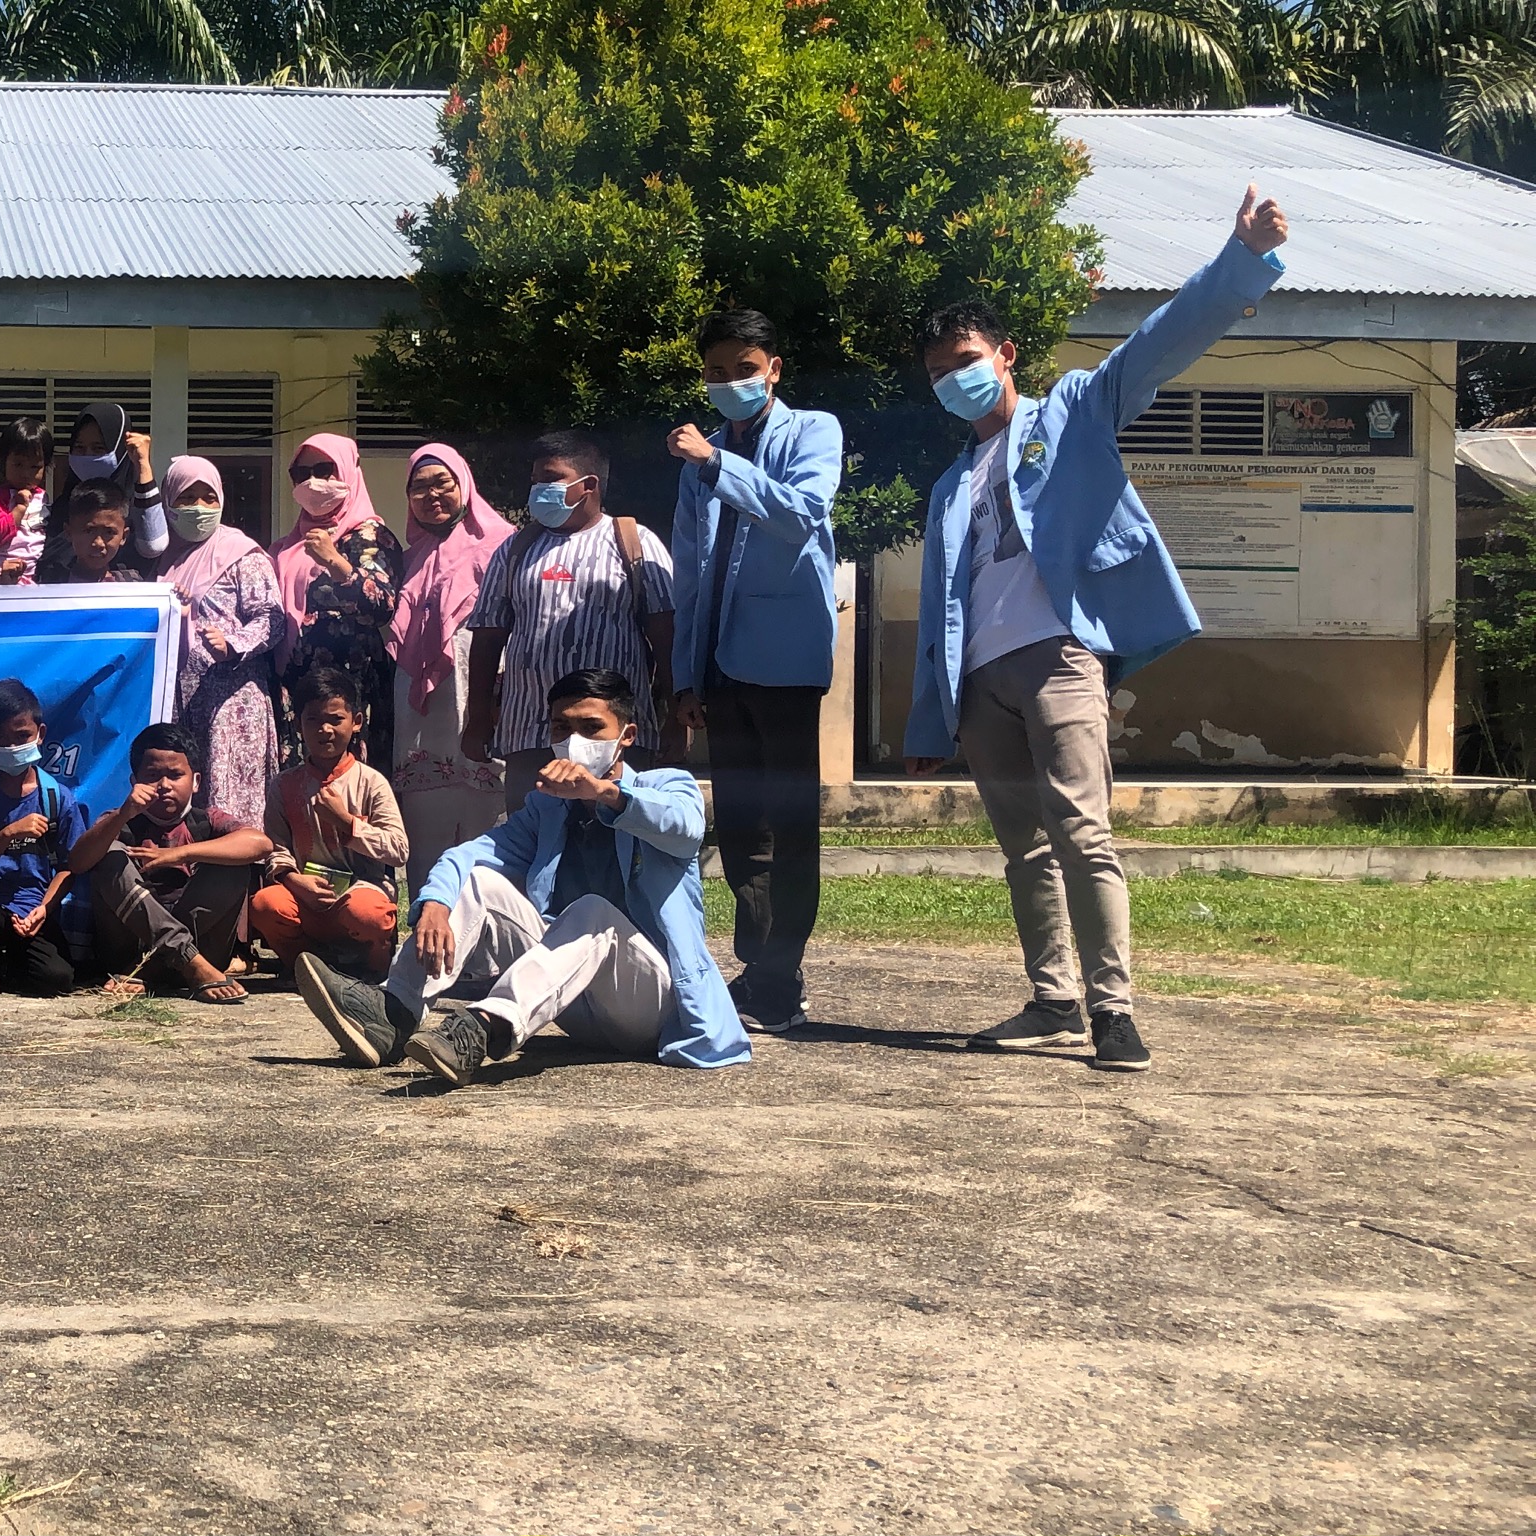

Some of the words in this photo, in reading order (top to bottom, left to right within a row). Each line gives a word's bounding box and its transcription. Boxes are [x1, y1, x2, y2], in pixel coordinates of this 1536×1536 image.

[1275, 442, 1334, 452] memusnahkan
[1336, 442, 1371, 455] generasi
[1131, 462, 1165, 471] PAPAN
[1168, 463, 1244, 473] PENGUMUMAN
[1247, 465, 1319, 475] PENGGUNAAN
[1321, 466, 1350, 475] DANA
[1354, 466, 1376, 475] BOS
